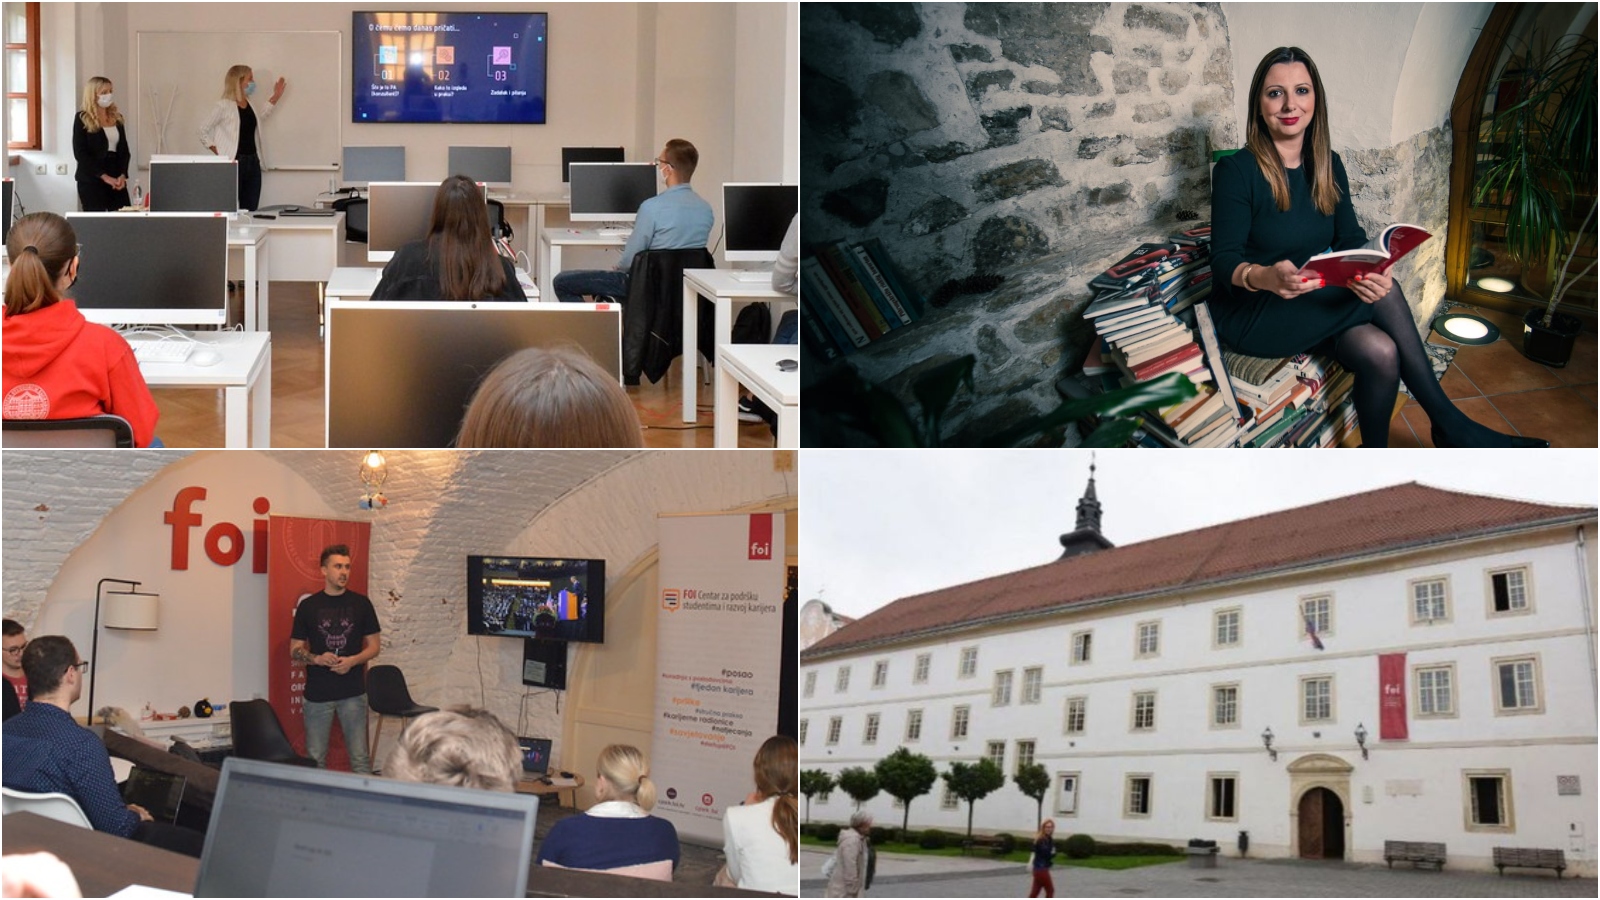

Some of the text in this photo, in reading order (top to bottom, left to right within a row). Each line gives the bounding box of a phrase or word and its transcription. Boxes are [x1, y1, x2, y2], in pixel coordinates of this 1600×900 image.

[381, 70, 394, 80] 01
[438, 70, 450, 80] 02
[495, 70, 507, 81] 03
[164, 486, 270, 574] foi
[750, 542, 769, 556] foi
[683, 589, 697, 599] FOI
[698, 591, 720, 600] Centar
[726, 603, 746, 613] razvoj
[748, 603, 776, 614] karijera
[722, 669, 753, 679] #posao
